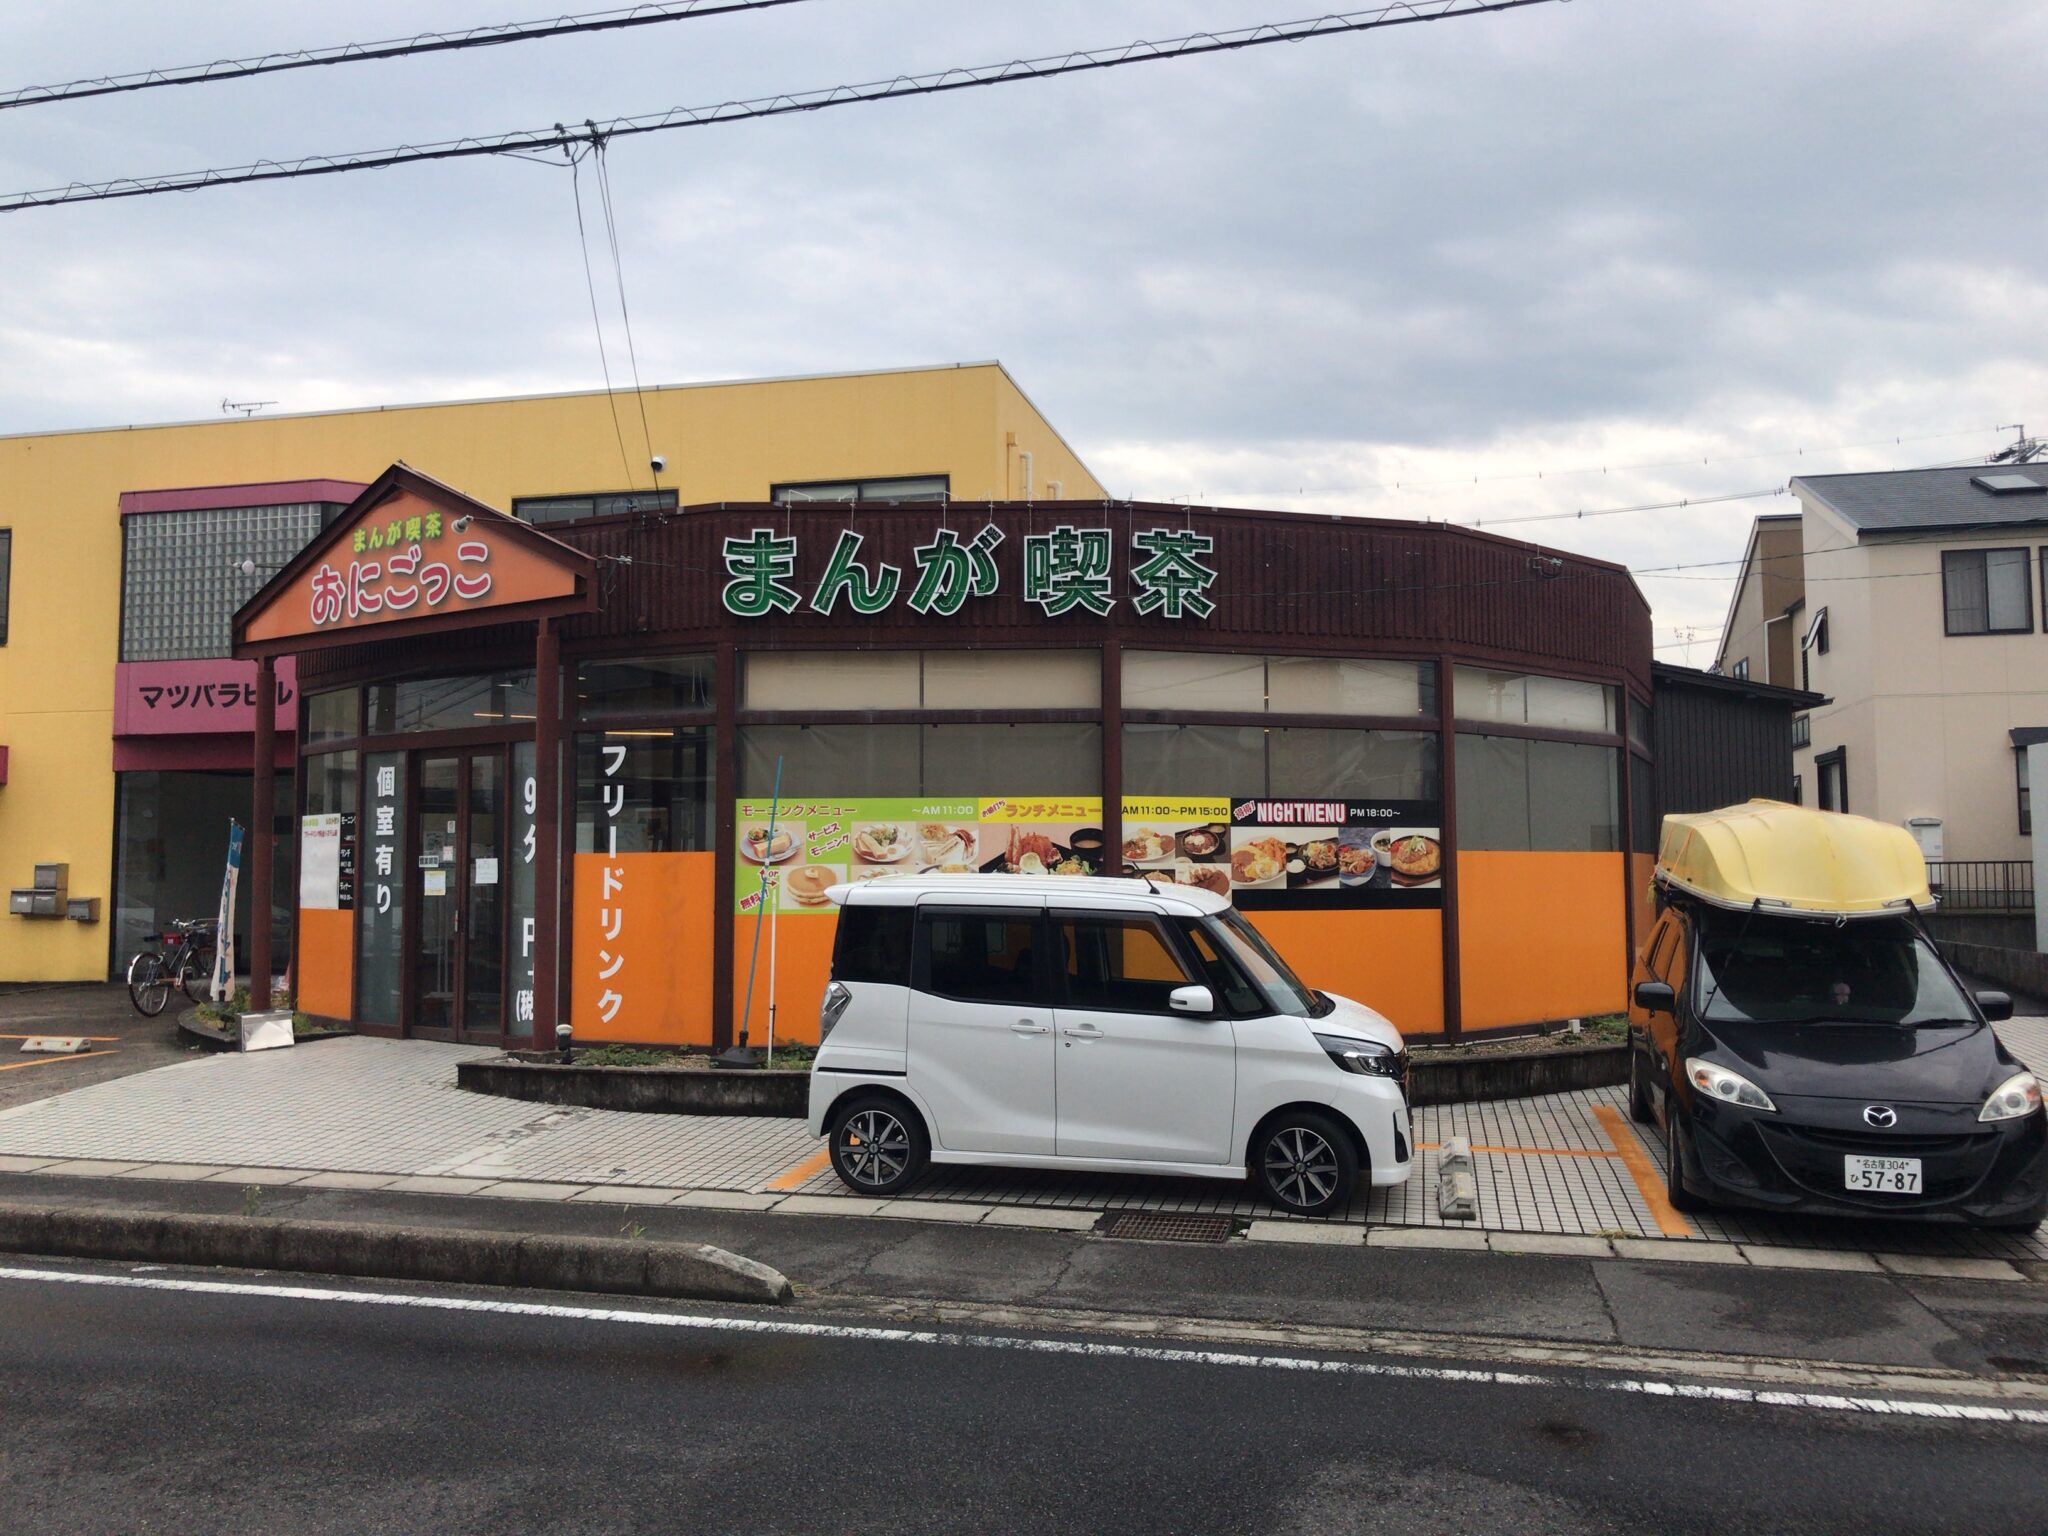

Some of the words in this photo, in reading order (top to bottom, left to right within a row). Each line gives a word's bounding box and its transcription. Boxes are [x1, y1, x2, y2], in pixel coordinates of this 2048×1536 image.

[352, 511, 442, 553] まんが喫茶
[722, 523, 1218, 619] まんが喫茶
[311, 543, 492, 625] おにごっこ
[742, 805, 856, 816] モーニングメニュー
[1005, 804, 1102, 818] ランチメニュー
[375, 766, 396, 914] 個室有り
[808, 822, 841, 841] サービス
[810, 834, 850, 856] モーニング
[598, 746, 627, 1024] フリードリンク
[768, 870, 779, 878] or
[1850, 1174, 1859, 1183] ひ
[1862, 1170, 1917, 1191] 57-87
